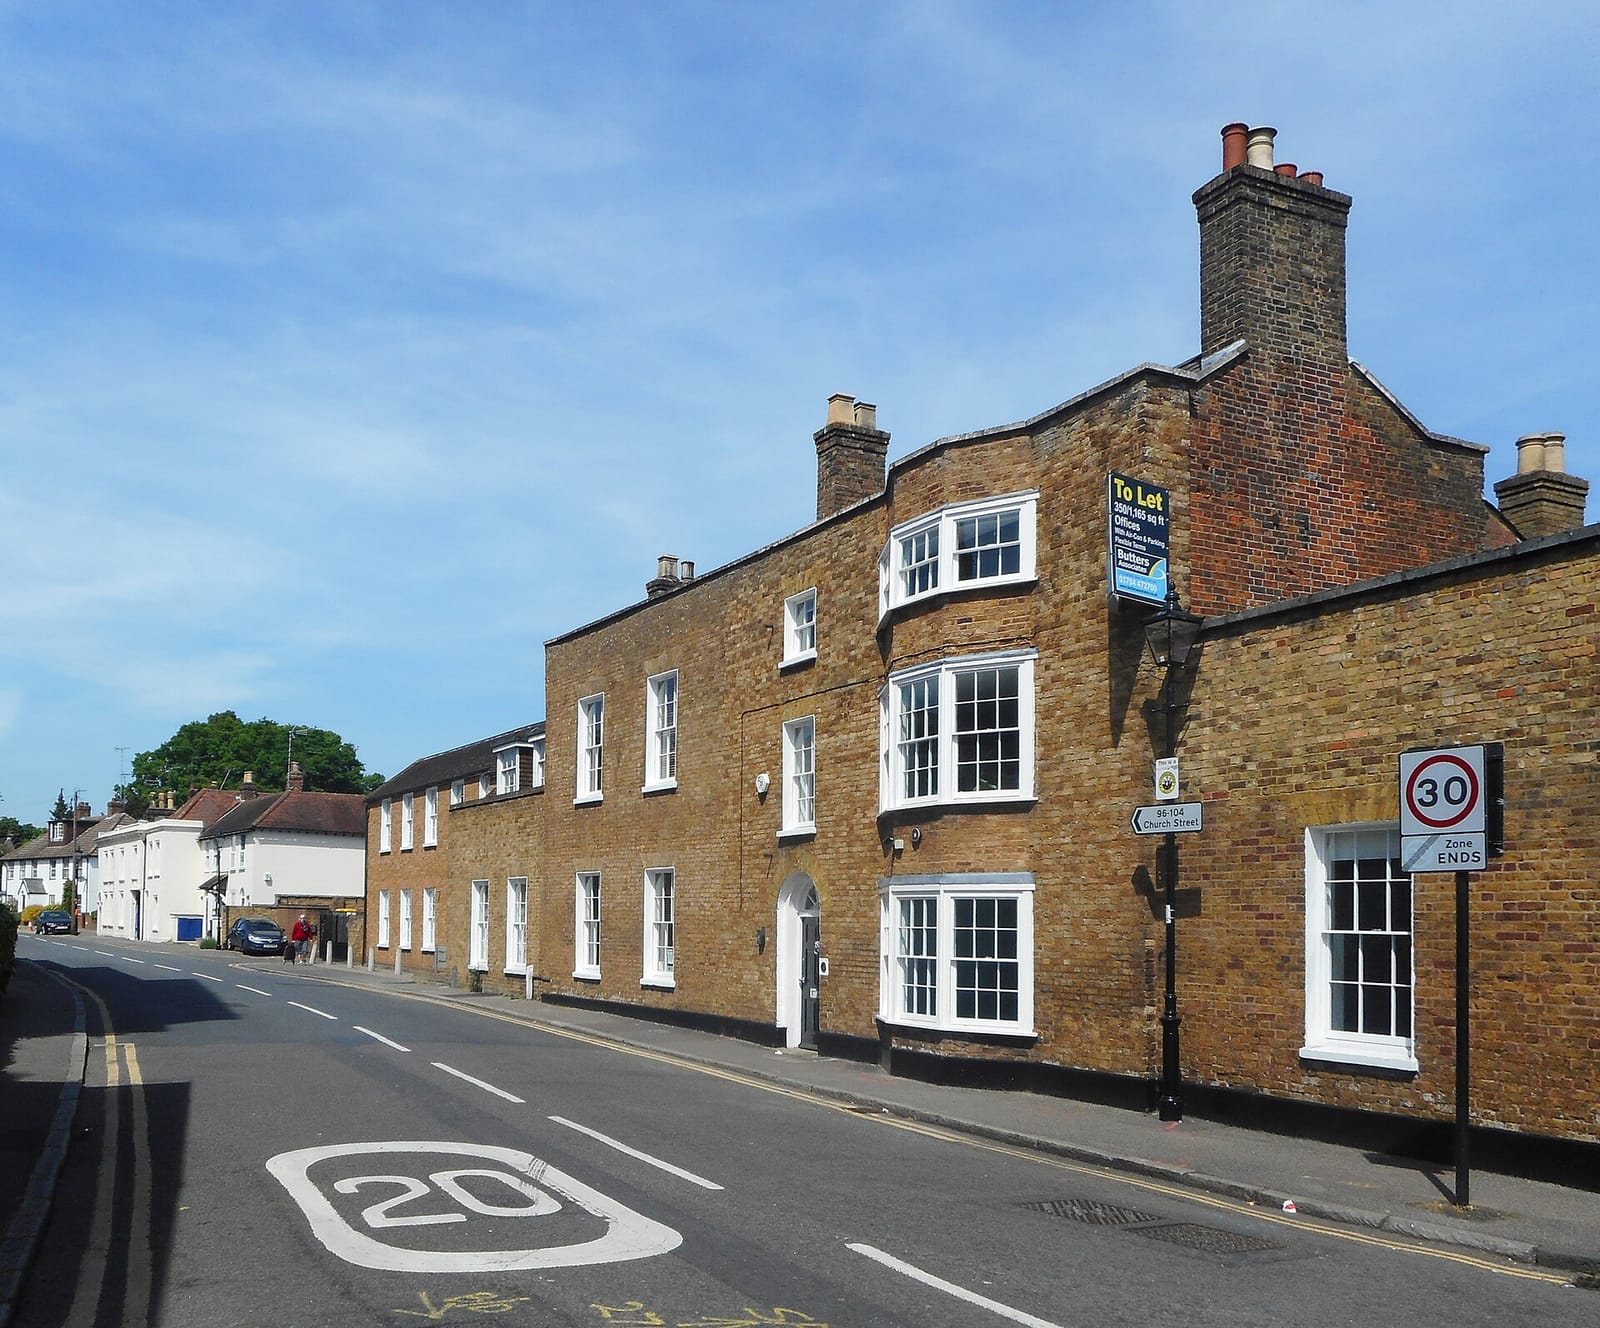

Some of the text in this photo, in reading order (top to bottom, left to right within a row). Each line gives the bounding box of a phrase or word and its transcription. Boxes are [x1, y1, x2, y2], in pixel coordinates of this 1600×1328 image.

[1114, 478, 1163, 511] To Let
[1114, 502, 1165, 526] 350/1,165 sq ft
[1115, 515, 1141, 531] Offices
[1148, 537, 1165, 548] Parking
[1118, 549, 1150, 566] Butters
[1118, 560, 1147, 574] Associates
[1417, 776, 1468, 807] 30
[1157, 808, 1184, 818] 96-104
[1144, 818, 1199, 829] Church Street
[1445, 839, 1473, 848] Zone
[1438, 851, 1481, 864] ENDS
[333, 1169, 562, 1228] 20
